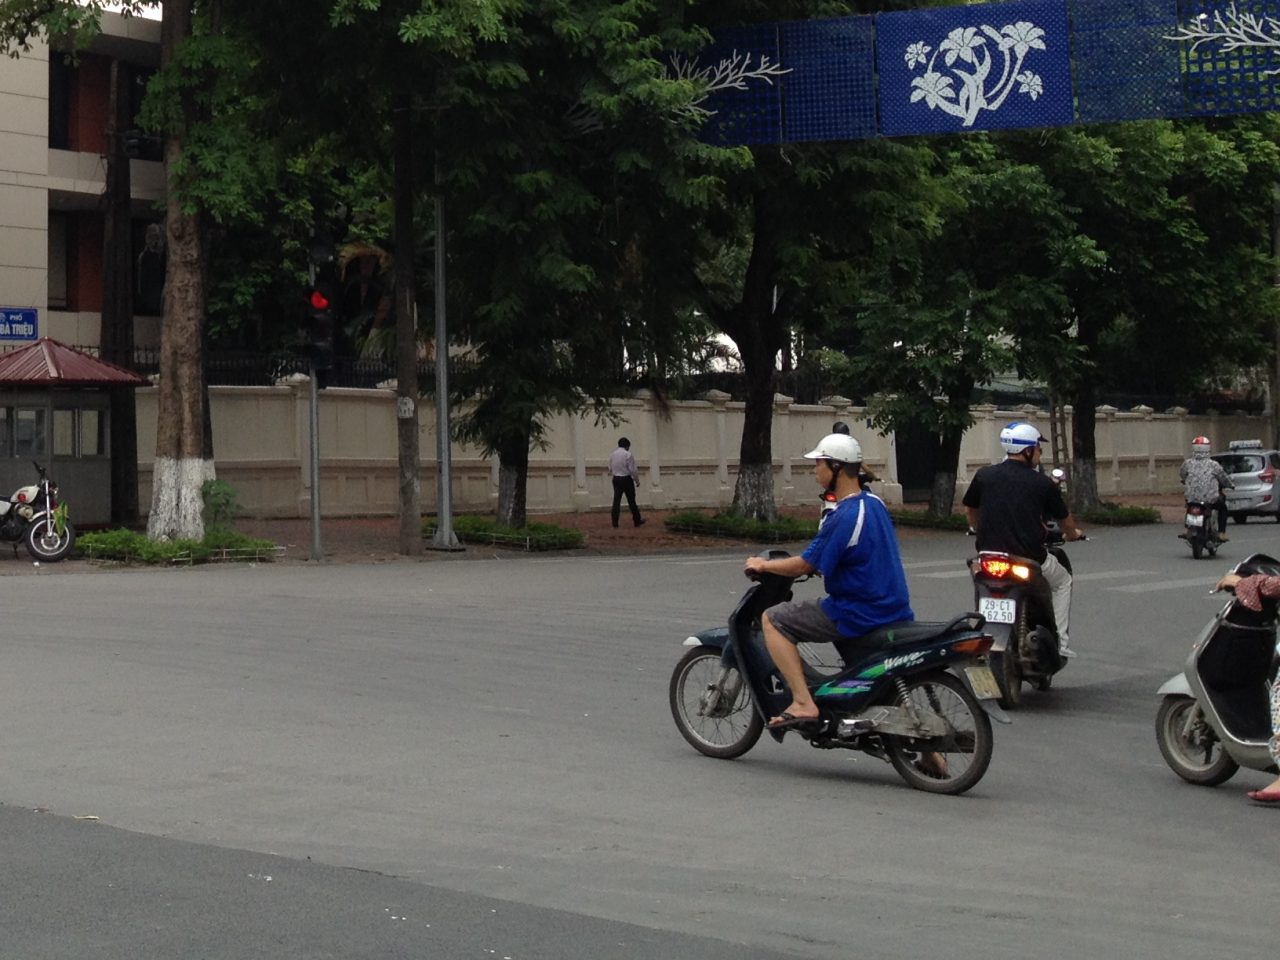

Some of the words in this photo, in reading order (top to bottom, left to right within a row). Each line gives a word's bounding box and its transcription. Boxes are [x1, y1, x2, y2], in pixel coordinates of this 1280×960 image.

[9, 313, 23, 321] PHỐ
[0, 322, 11, 335] BÀ
[12, 321, 34, 338] TRIỆU
[984, 600, 1011, 611] 29-C1
[883, 650, 932, 671] Wave
